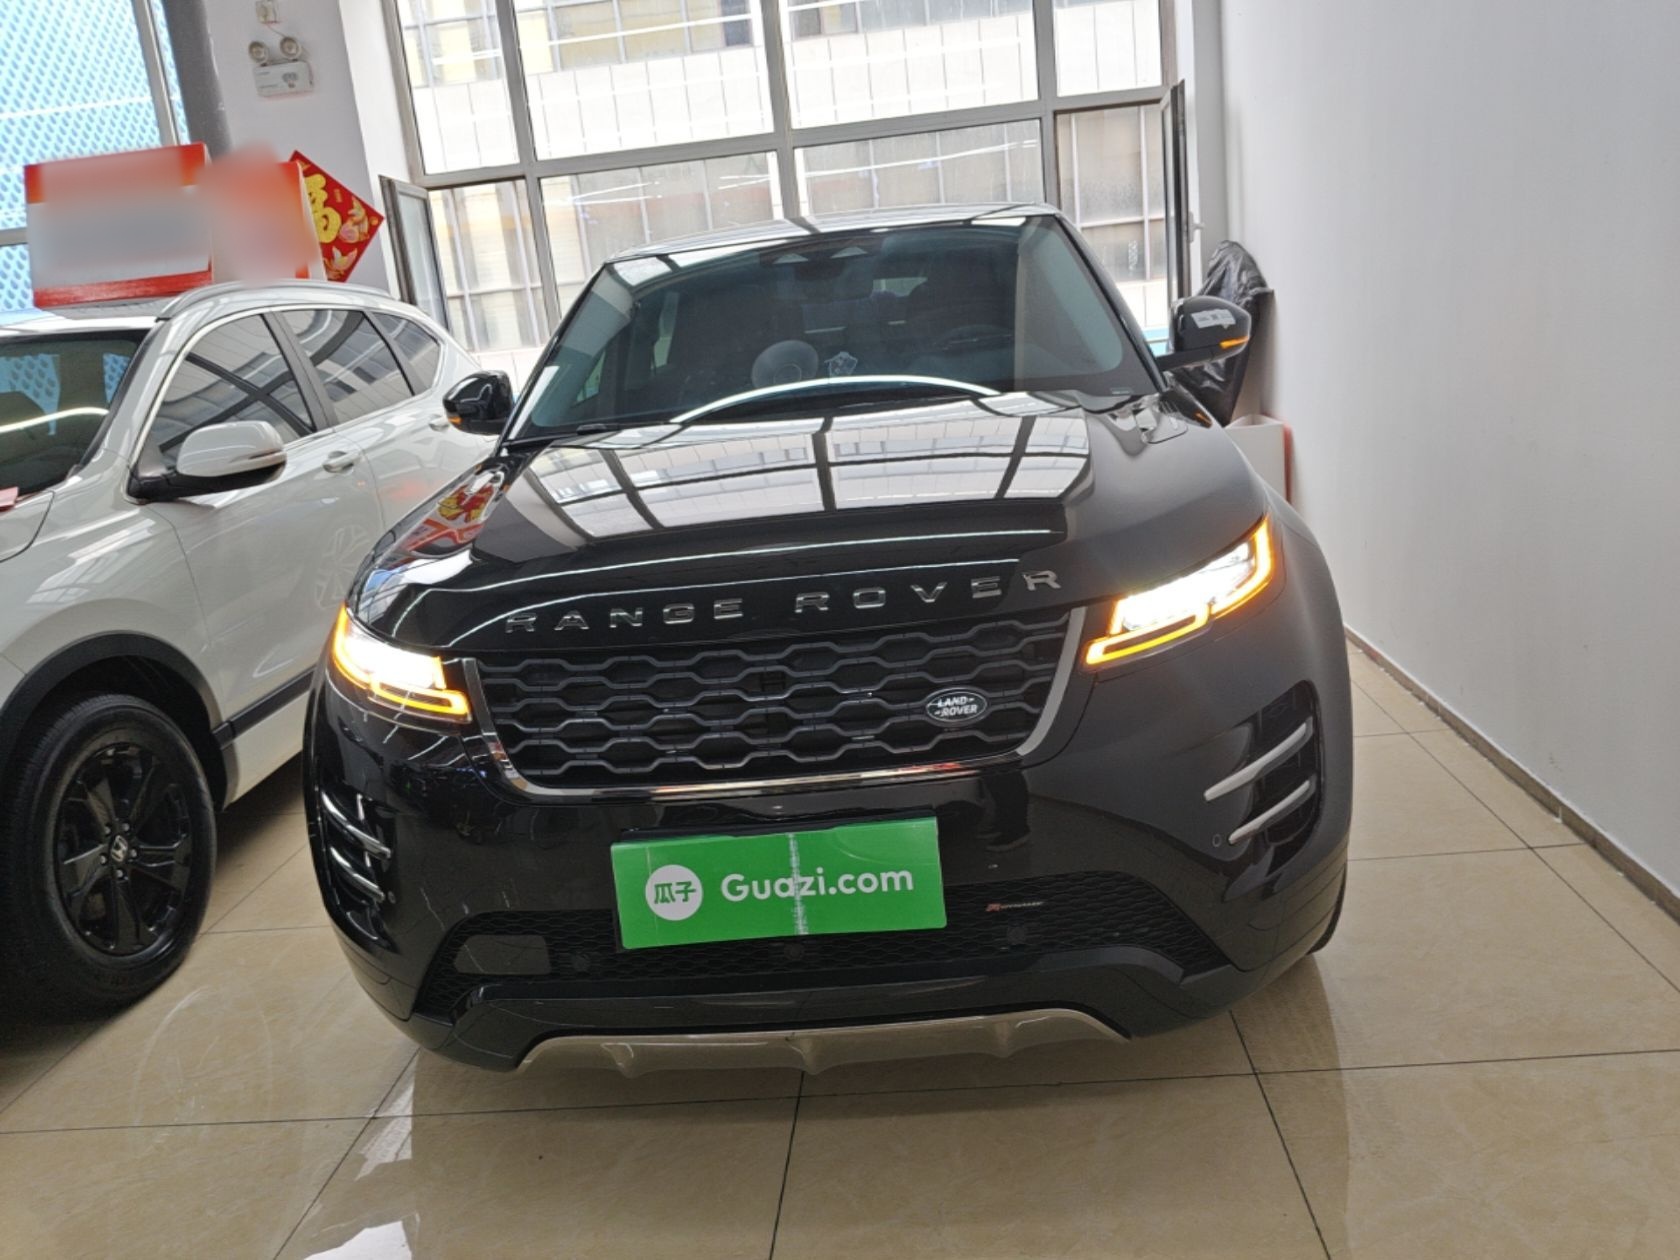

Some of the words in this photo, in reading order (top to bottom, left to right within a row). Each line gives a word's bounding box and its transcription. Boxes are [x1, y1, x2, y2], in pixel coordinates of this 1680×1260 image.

[505, 598, 743, 633] RANGE
[795, 570, 1061, 613] ROVER
[653, 880, 697, 905] 瓜子
[720, 867, 914, 902] Guazi.com
